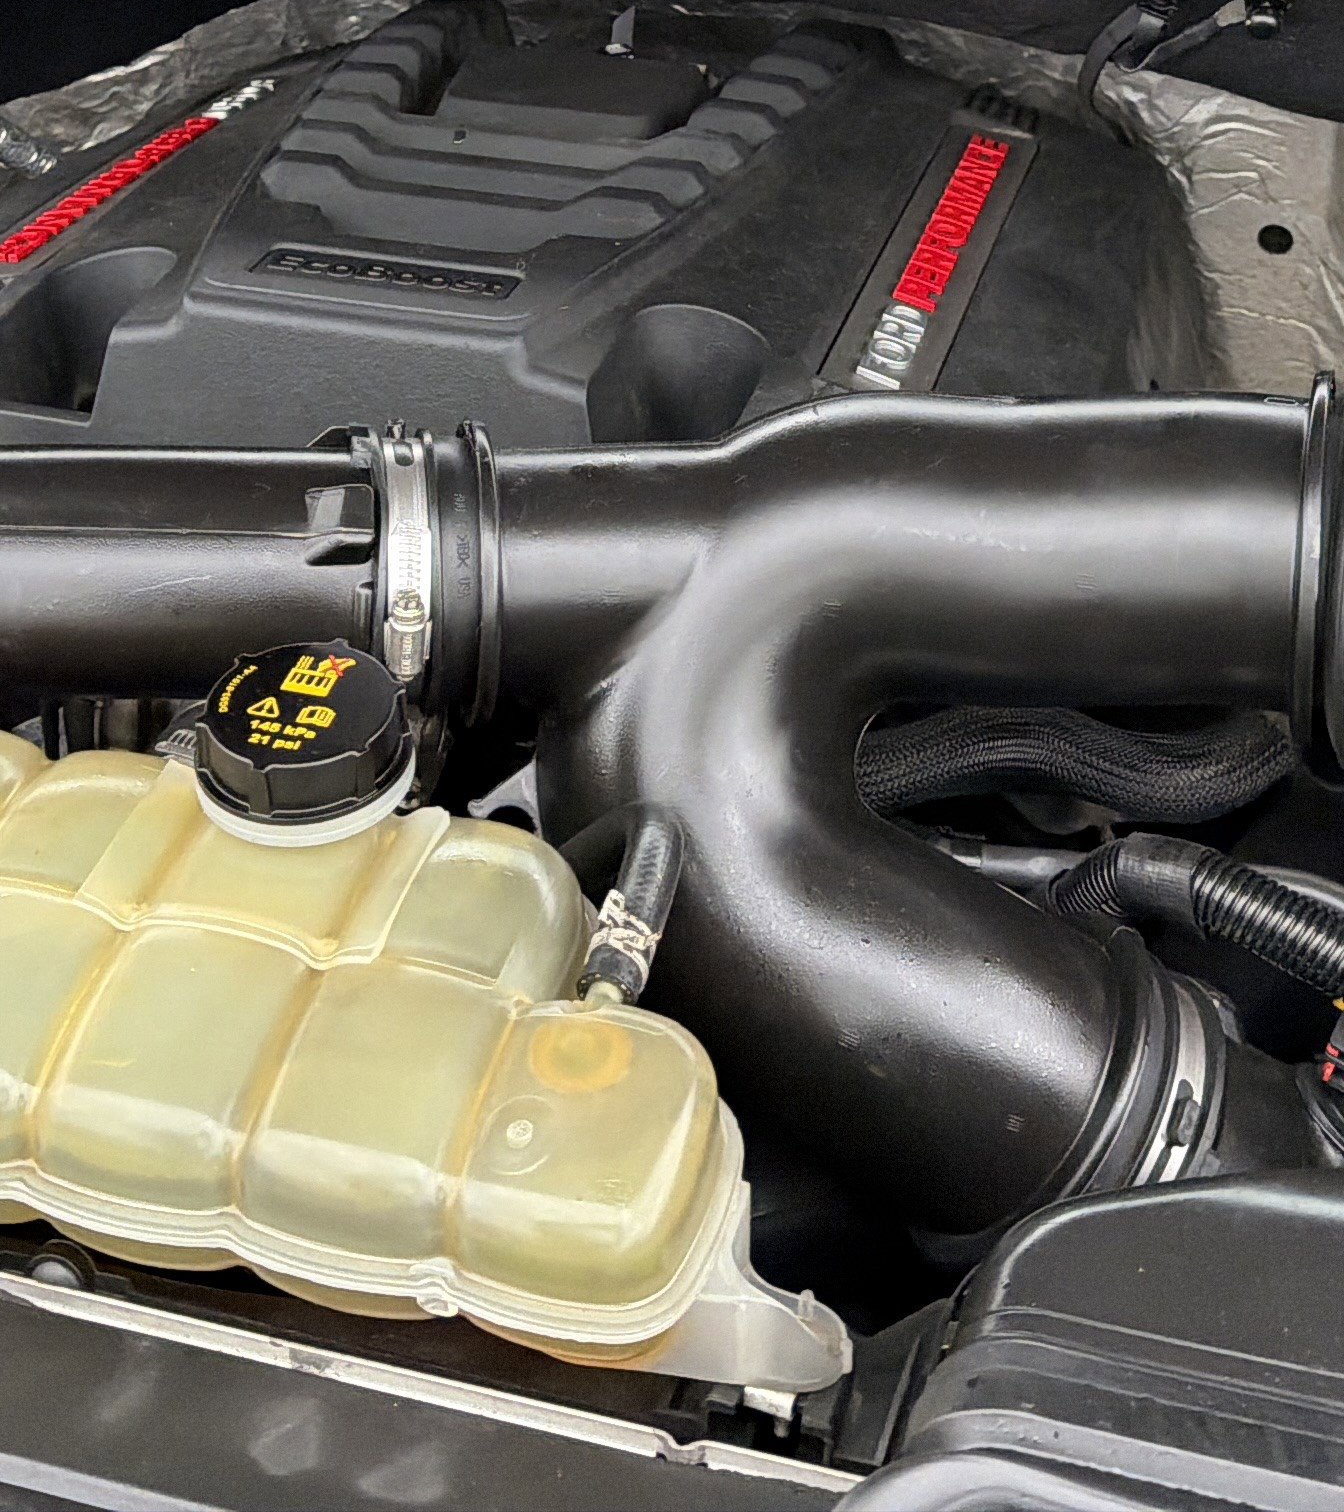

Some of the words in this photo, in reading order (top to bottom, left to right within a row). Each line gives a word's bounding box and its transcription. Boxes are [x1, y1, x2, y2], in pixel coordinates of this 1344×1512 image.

[855, 304, 928, 390] FORD
[892, 133, 1011, 313] PERFORMANCE
[250, 719, 282, 733] 145
[283, 725, 316, 739] kPa
[248, 733, 271, 745] 21
[272, 739, 302, 751] psi
